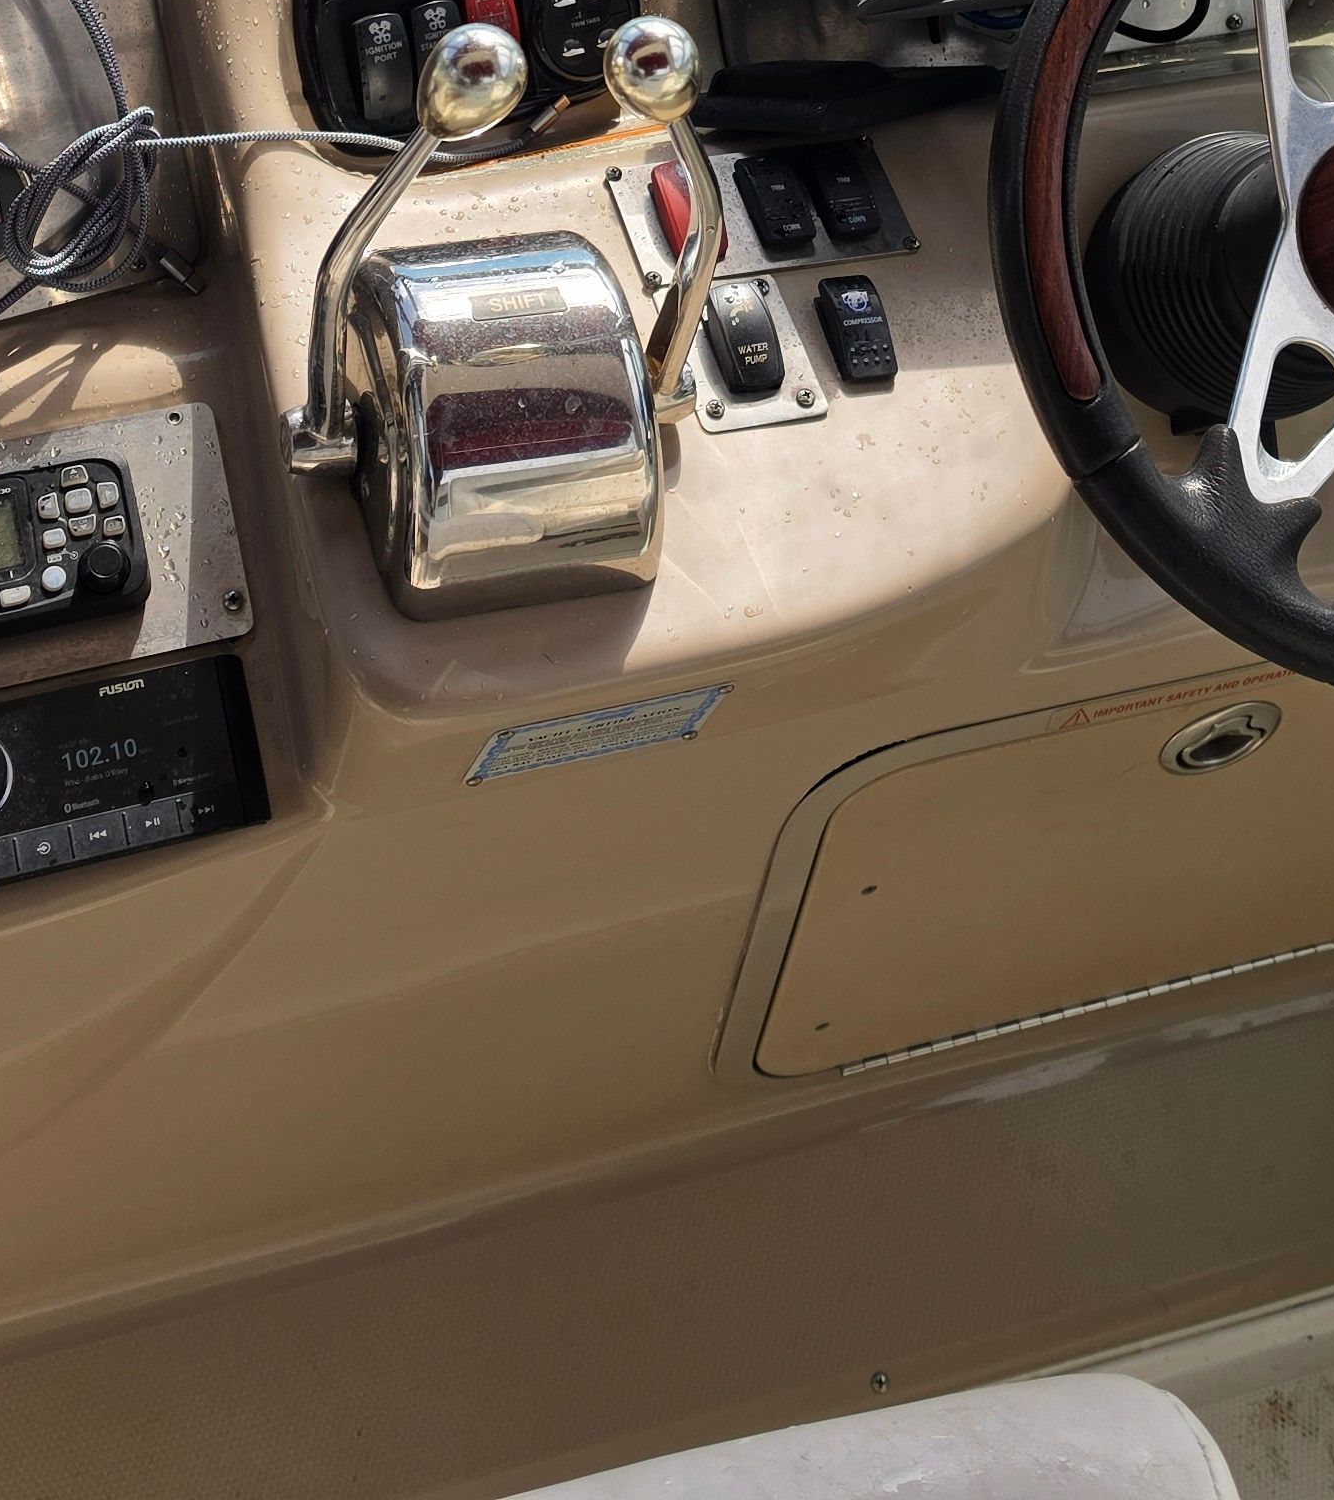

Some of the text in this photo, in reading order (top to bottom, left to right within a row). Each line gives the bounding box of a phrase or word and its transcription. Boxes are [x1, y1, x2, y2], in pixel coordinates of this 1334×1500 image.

[364, 41, 403, 56] IGNITION
[374, 52, 398, 63] PORT
[783, 223, 801, 232] DOWN
[490, 293, 545, 312] SHIFT
[843, 316, 883, 327] COMPRESSOR
[737, 342, 769, 355] WATER
[745, 352, 768, 366] PUMP
[1092, 697, 1165, 719] IMPORTANT
[1167, 686, 1213, 703] SAFETY
[1213, 679, 1240, 693] AND
[62, 738, 138, 772] 102.10
